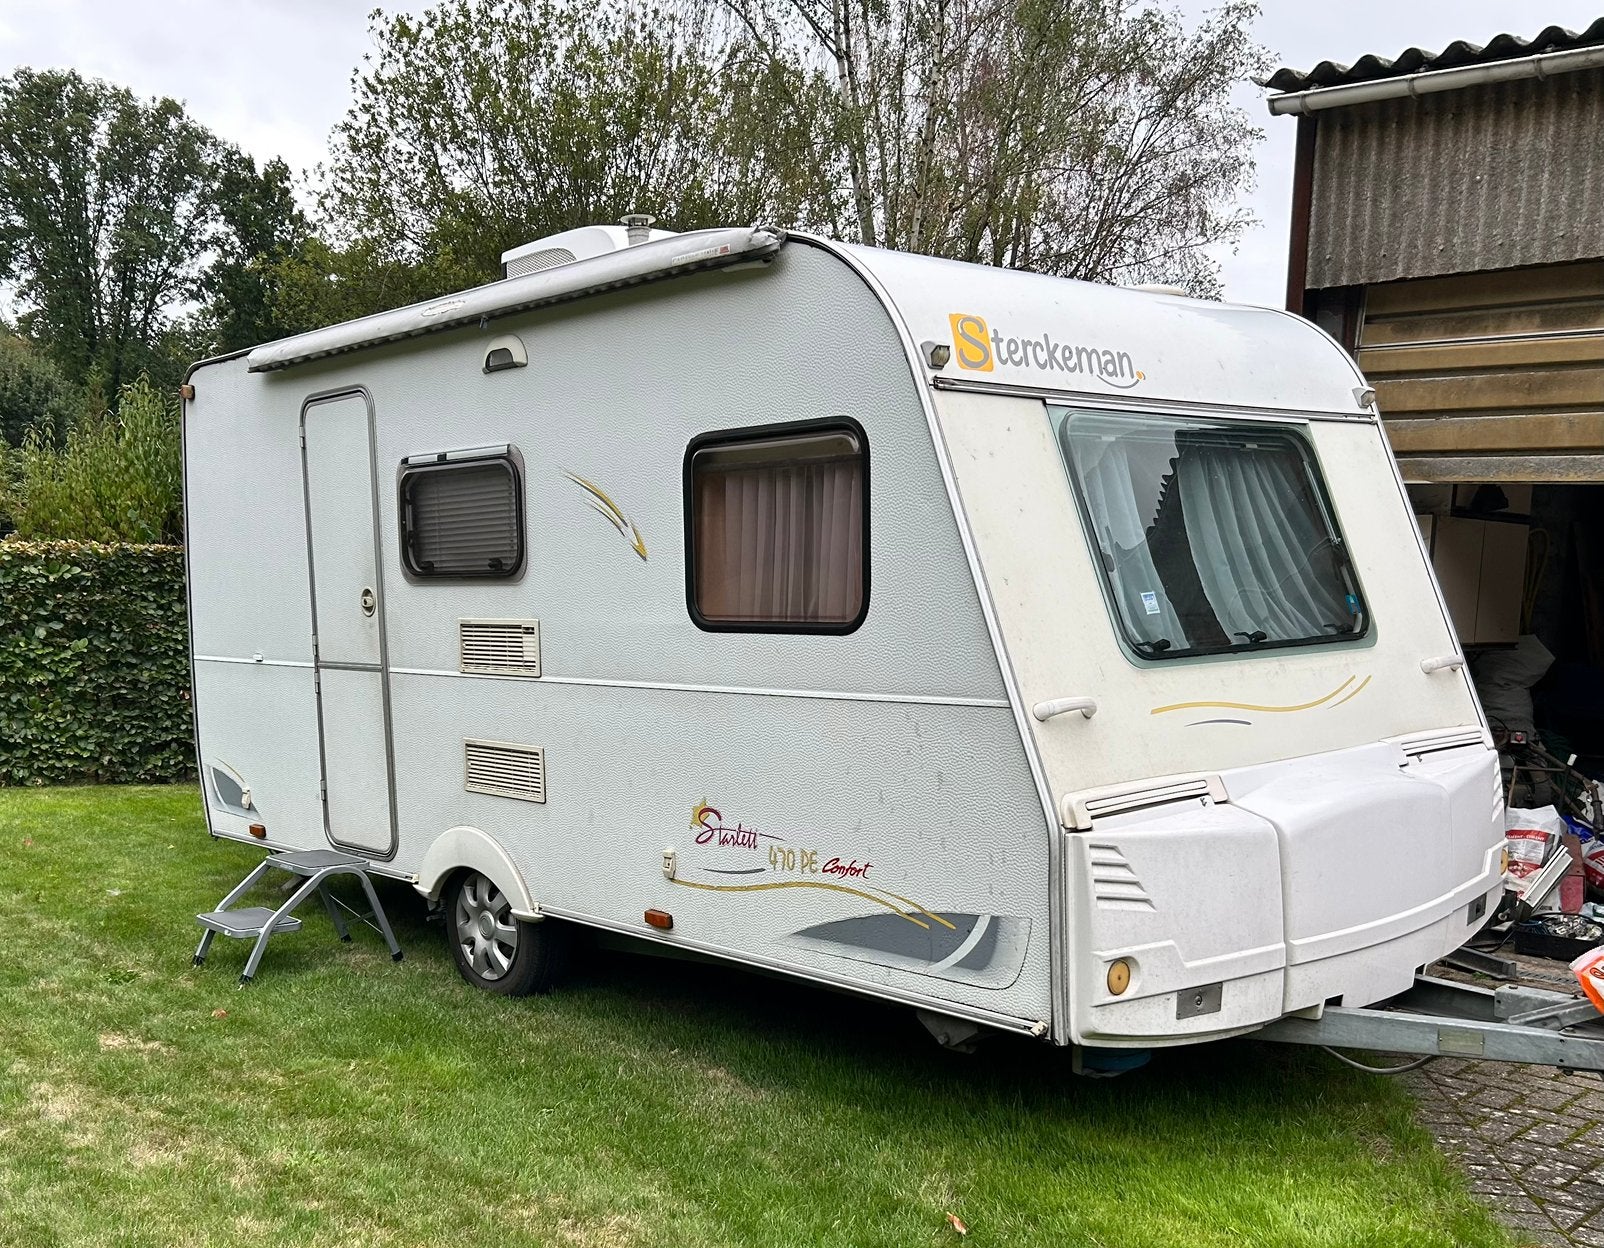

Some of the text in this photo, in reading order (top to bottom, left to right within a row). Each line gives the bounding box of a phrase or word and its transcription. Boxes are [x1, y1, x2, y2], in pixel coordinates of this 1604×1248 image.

[956, 315, 1135, 379] Sterckeman
[695, 807, 760, 850] Starlett
[768, 845, 874, 880] 470 PE Confort
